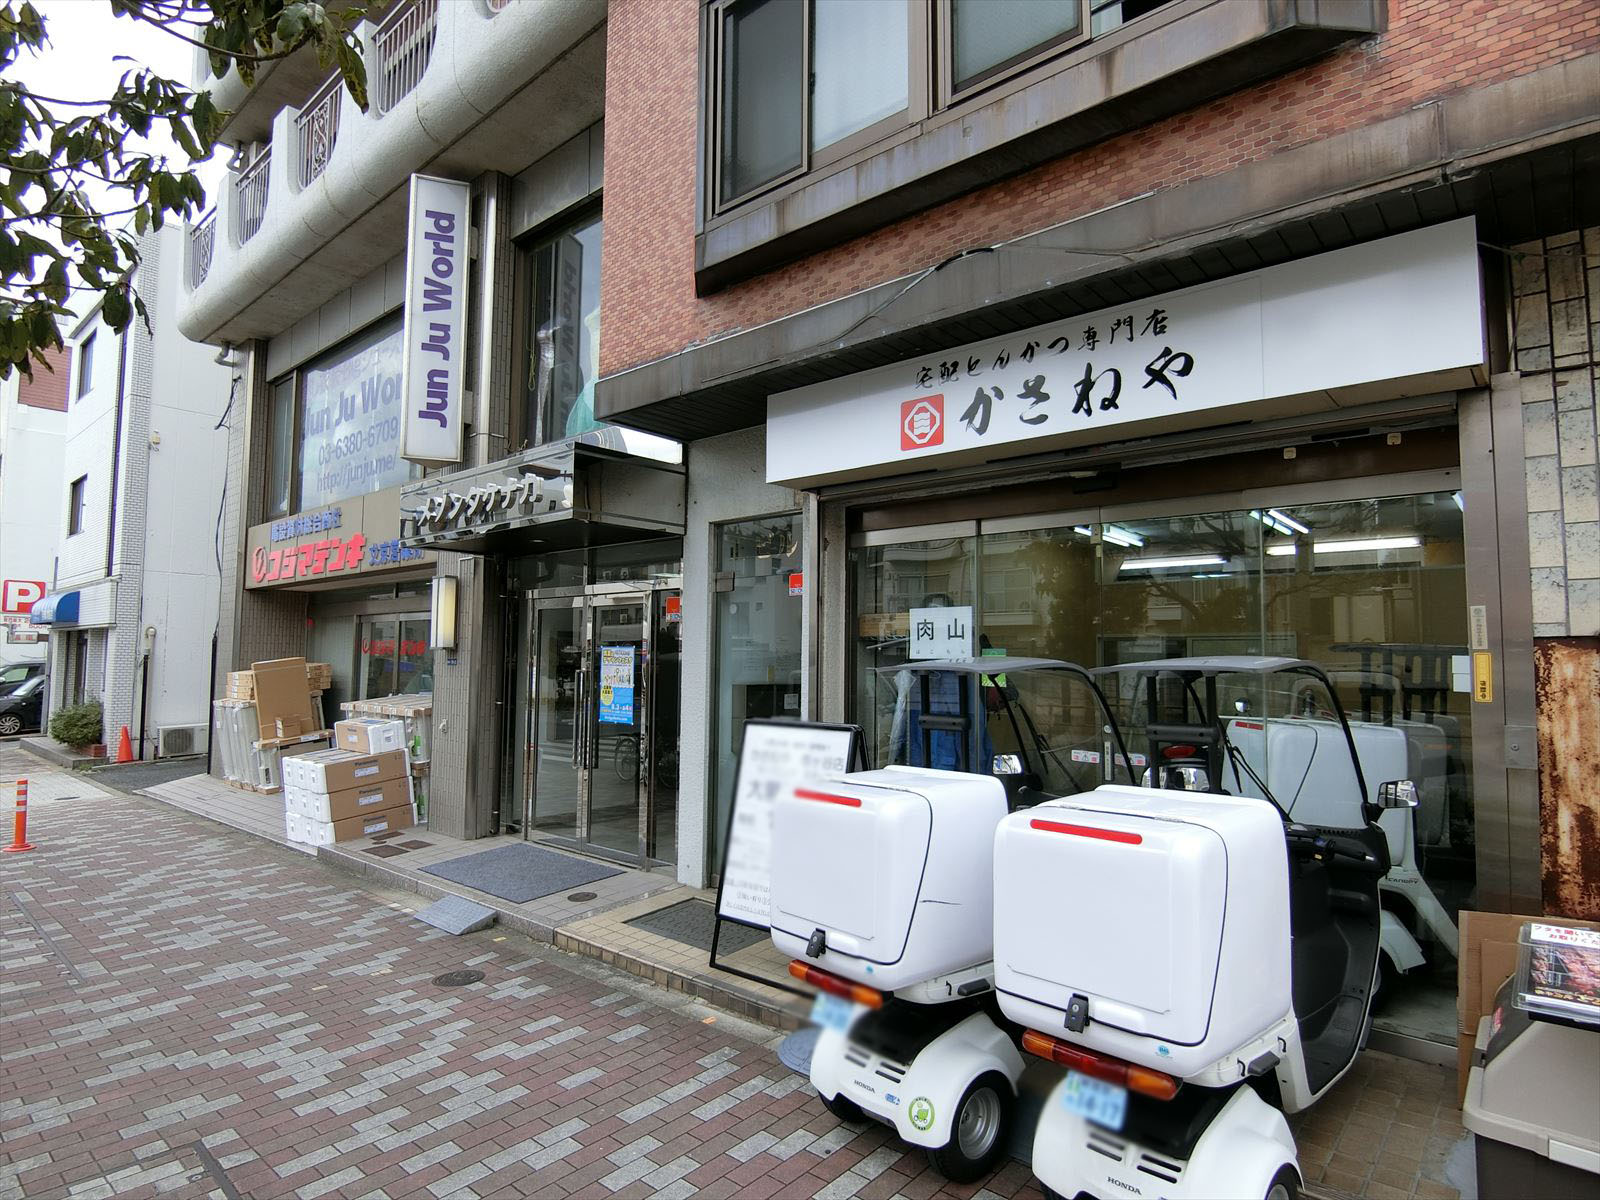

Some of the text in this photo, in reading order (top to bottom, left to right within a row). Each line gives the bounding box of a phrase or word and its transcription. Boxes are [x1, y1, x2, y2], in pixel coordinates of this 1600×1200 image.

[418, 209, 456, 428] Jun Ju World
[915, 309, 1169, 389] 宅配とんかつ専門店
[335, 390, 356, 427] Ju
[959, 346, 1194, 436] かさねや
[318, 415, 399, 466] 03-6380-6709
[316, 446, 398, 494] http://junju.me/
[6, 582, 41, 612] P
[916, 618, 965, 641] 肉山
[853, 1079, 876, 1094] HONDA
[1107, 1176, 1143, 1196] HONDA
